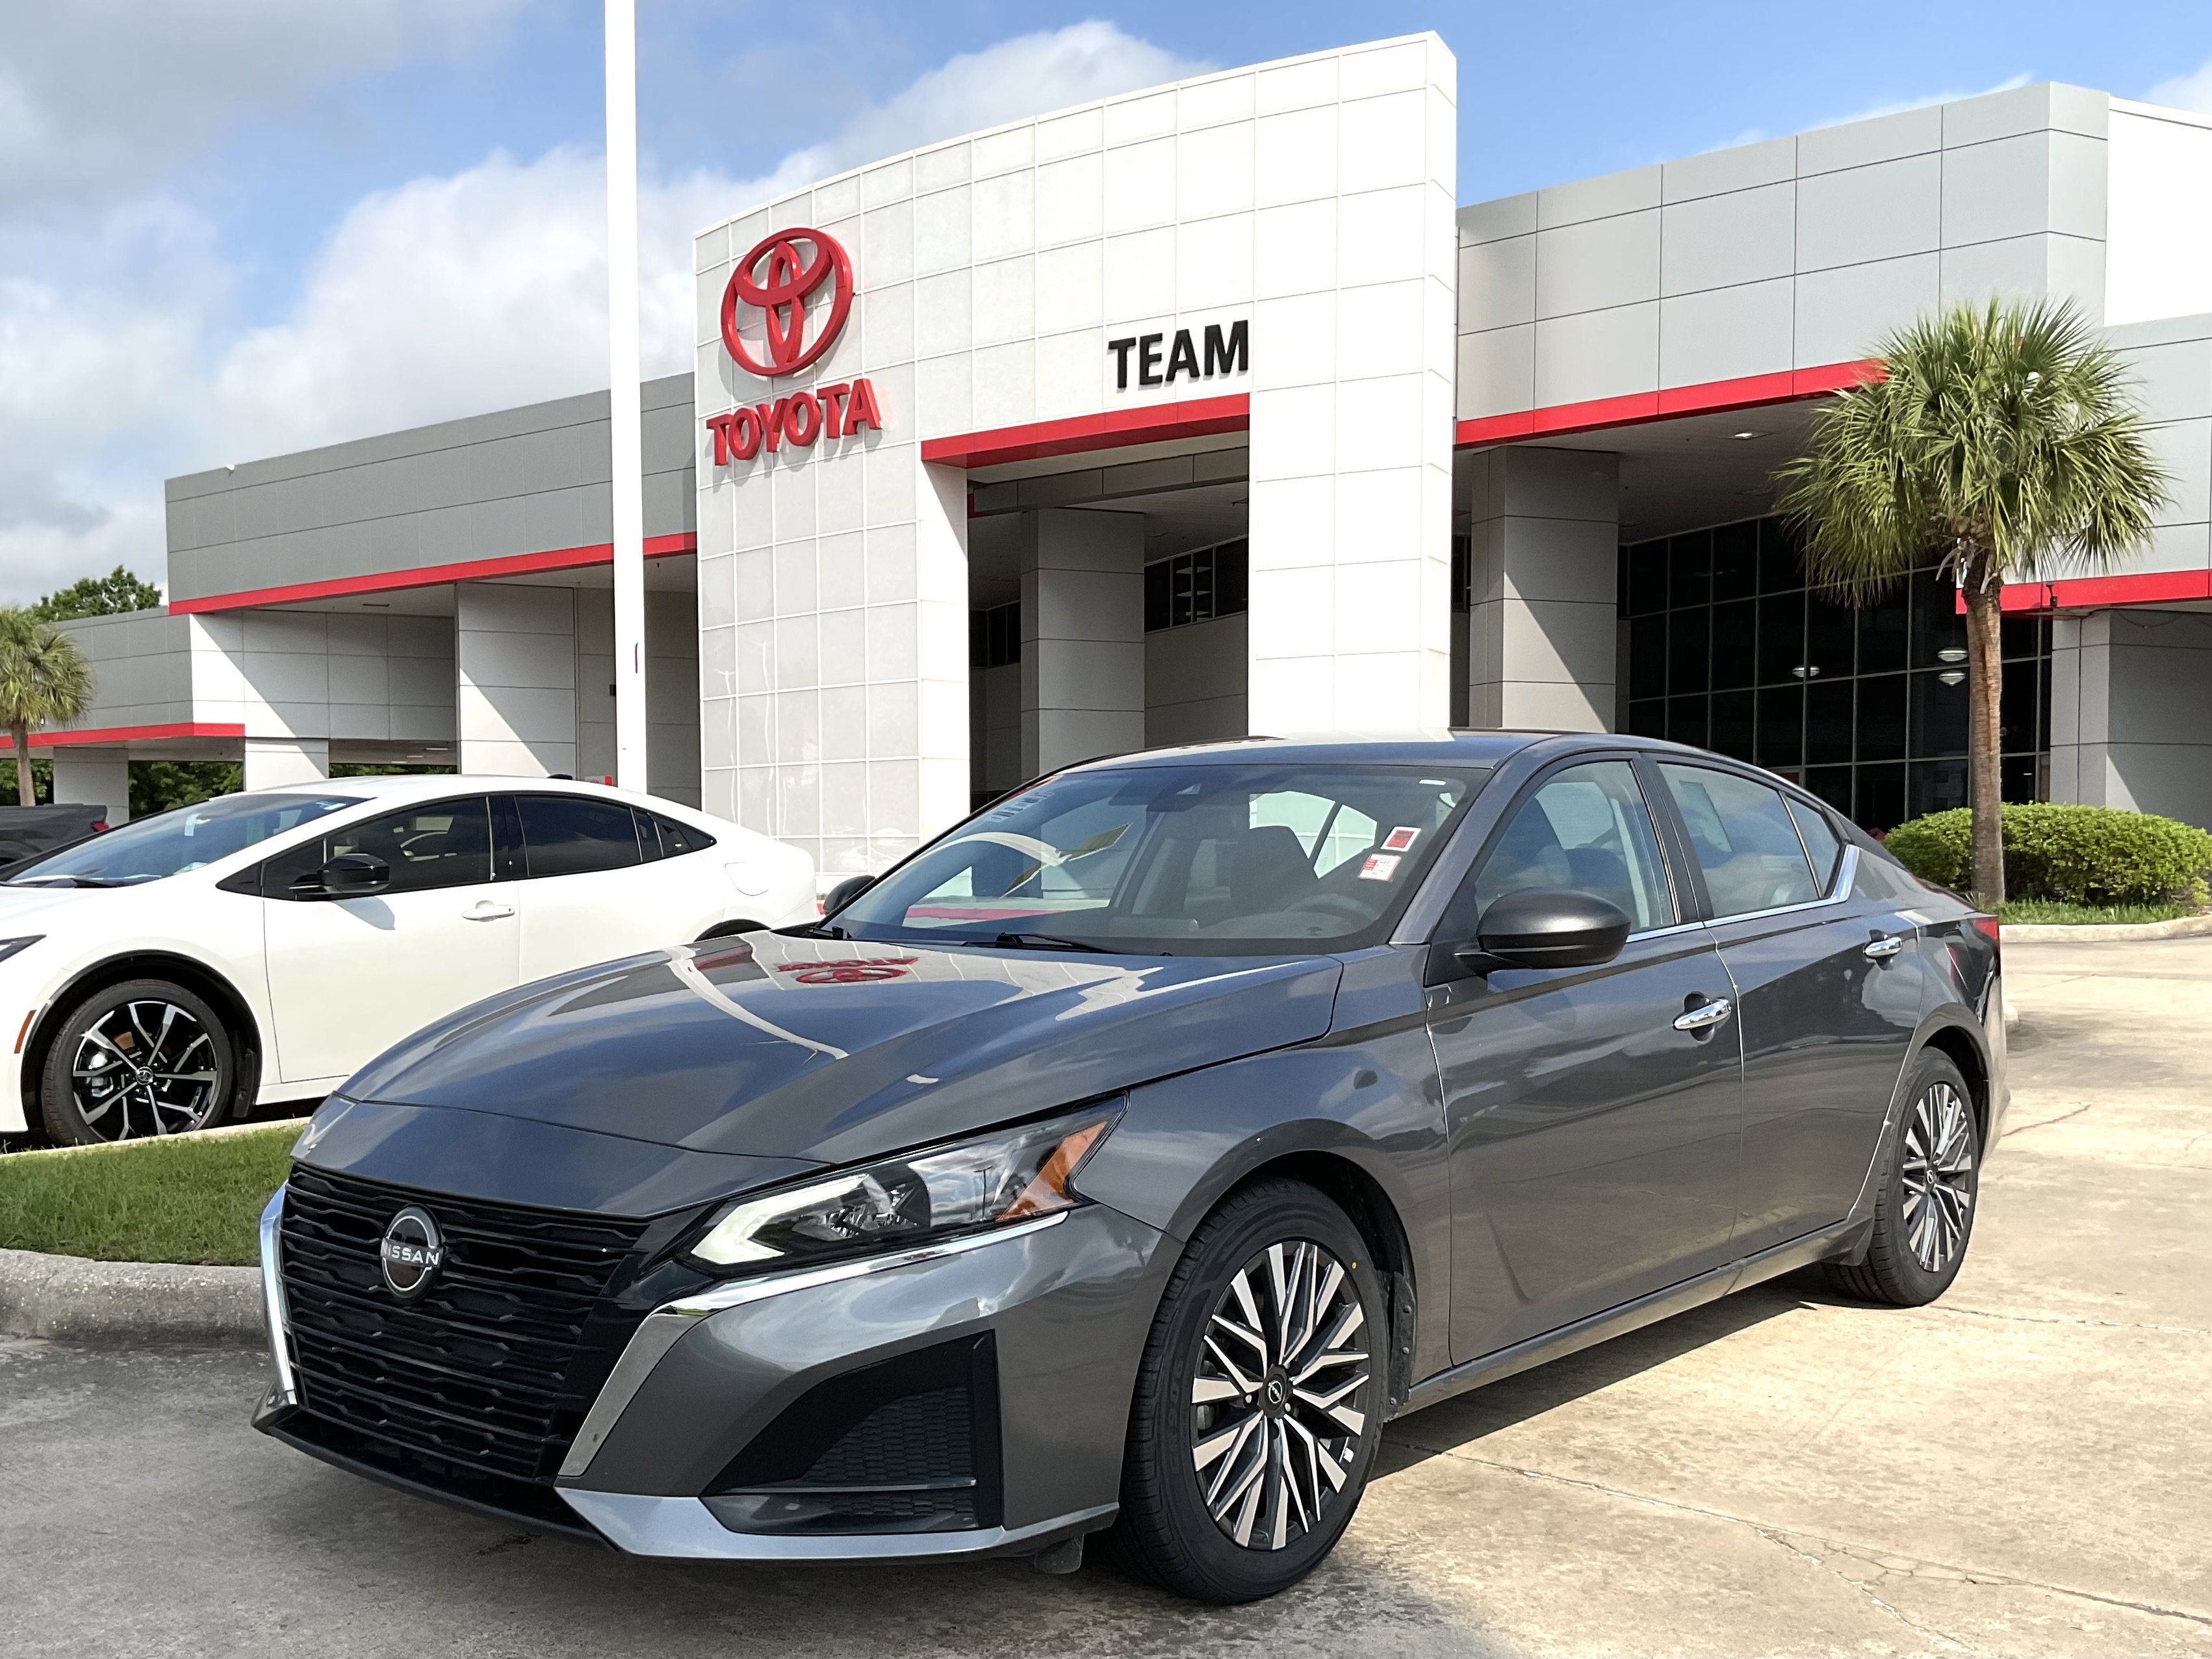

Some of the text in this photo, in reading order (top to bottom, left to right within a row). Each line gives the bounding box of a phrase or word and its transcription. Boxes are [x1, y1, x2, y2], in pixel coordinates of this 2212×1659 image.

[1109, 320, 1248, 388] TEAM
[706, 378, 884, 466] TOYOTA
[380, 1239, 439, 1265] NISSAN
